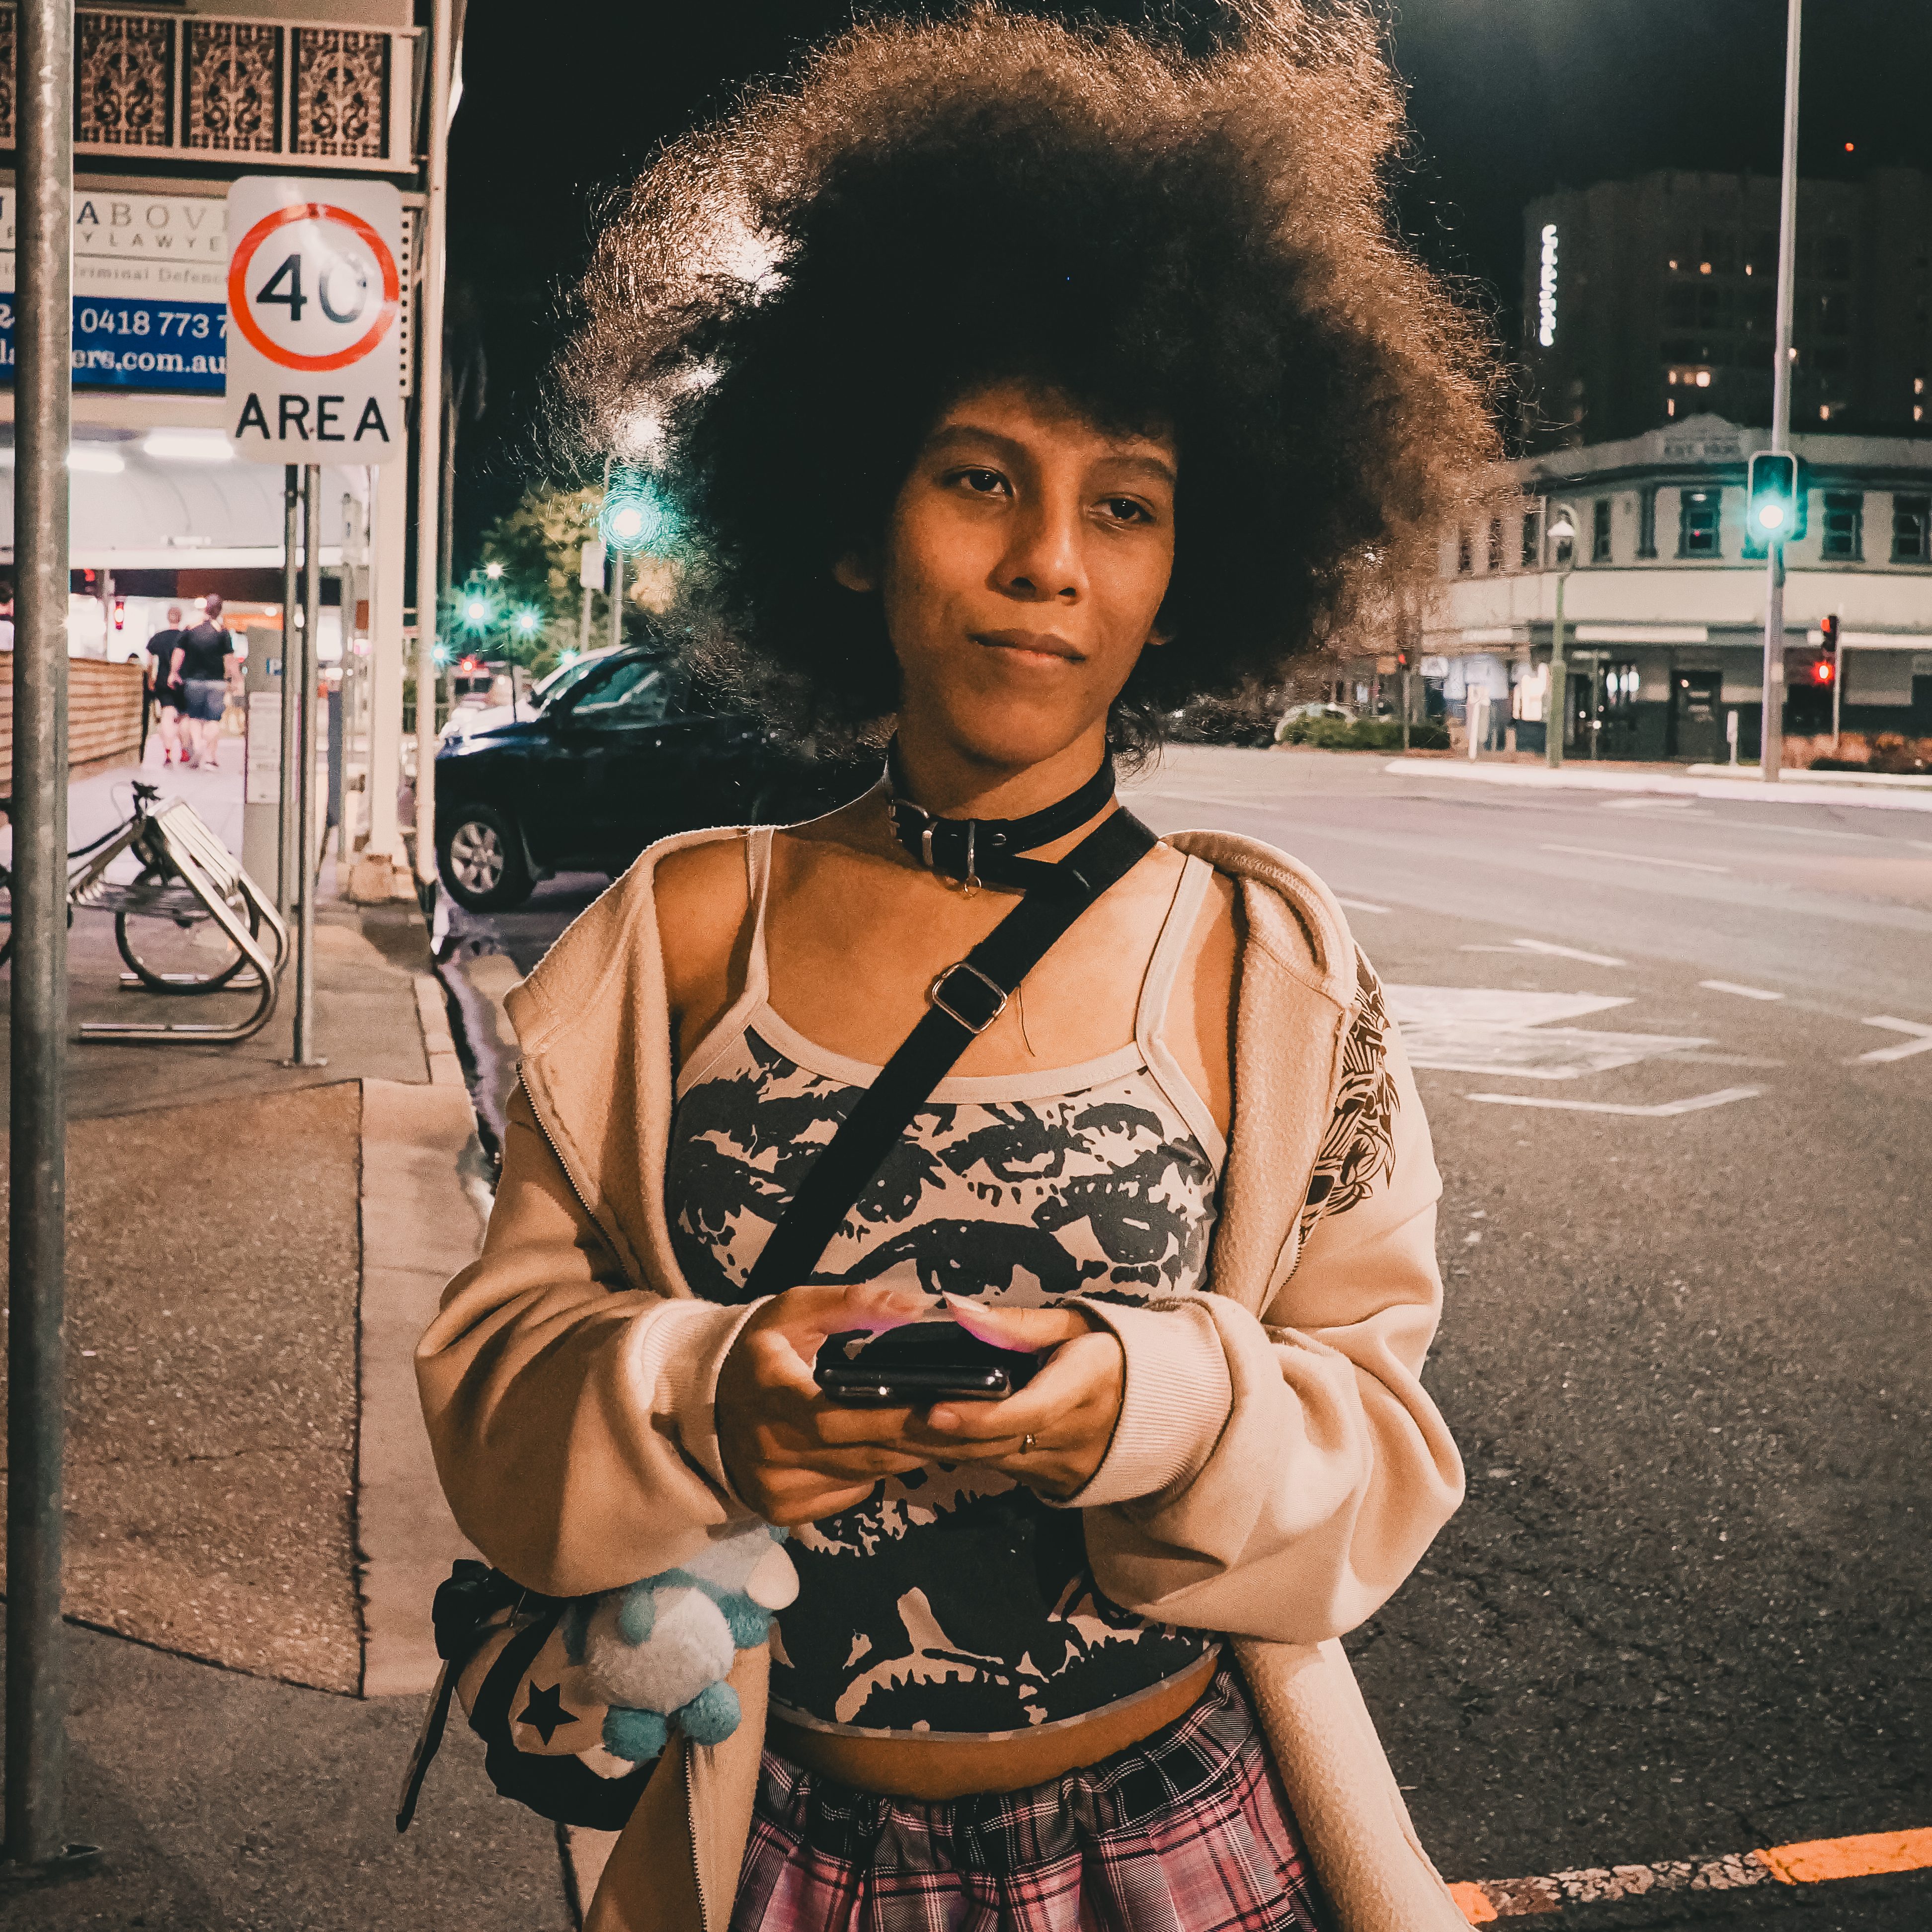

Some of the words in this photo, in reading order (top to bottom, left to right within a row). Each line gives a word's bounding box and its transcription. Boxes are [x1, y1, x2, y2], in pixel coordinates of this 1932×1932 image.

[255, 253, 367, 324] 40
[80, 308, 150, 336] 0418
[157, 312, 210, 339] 773
[235, 392, 391, 443] AREA
